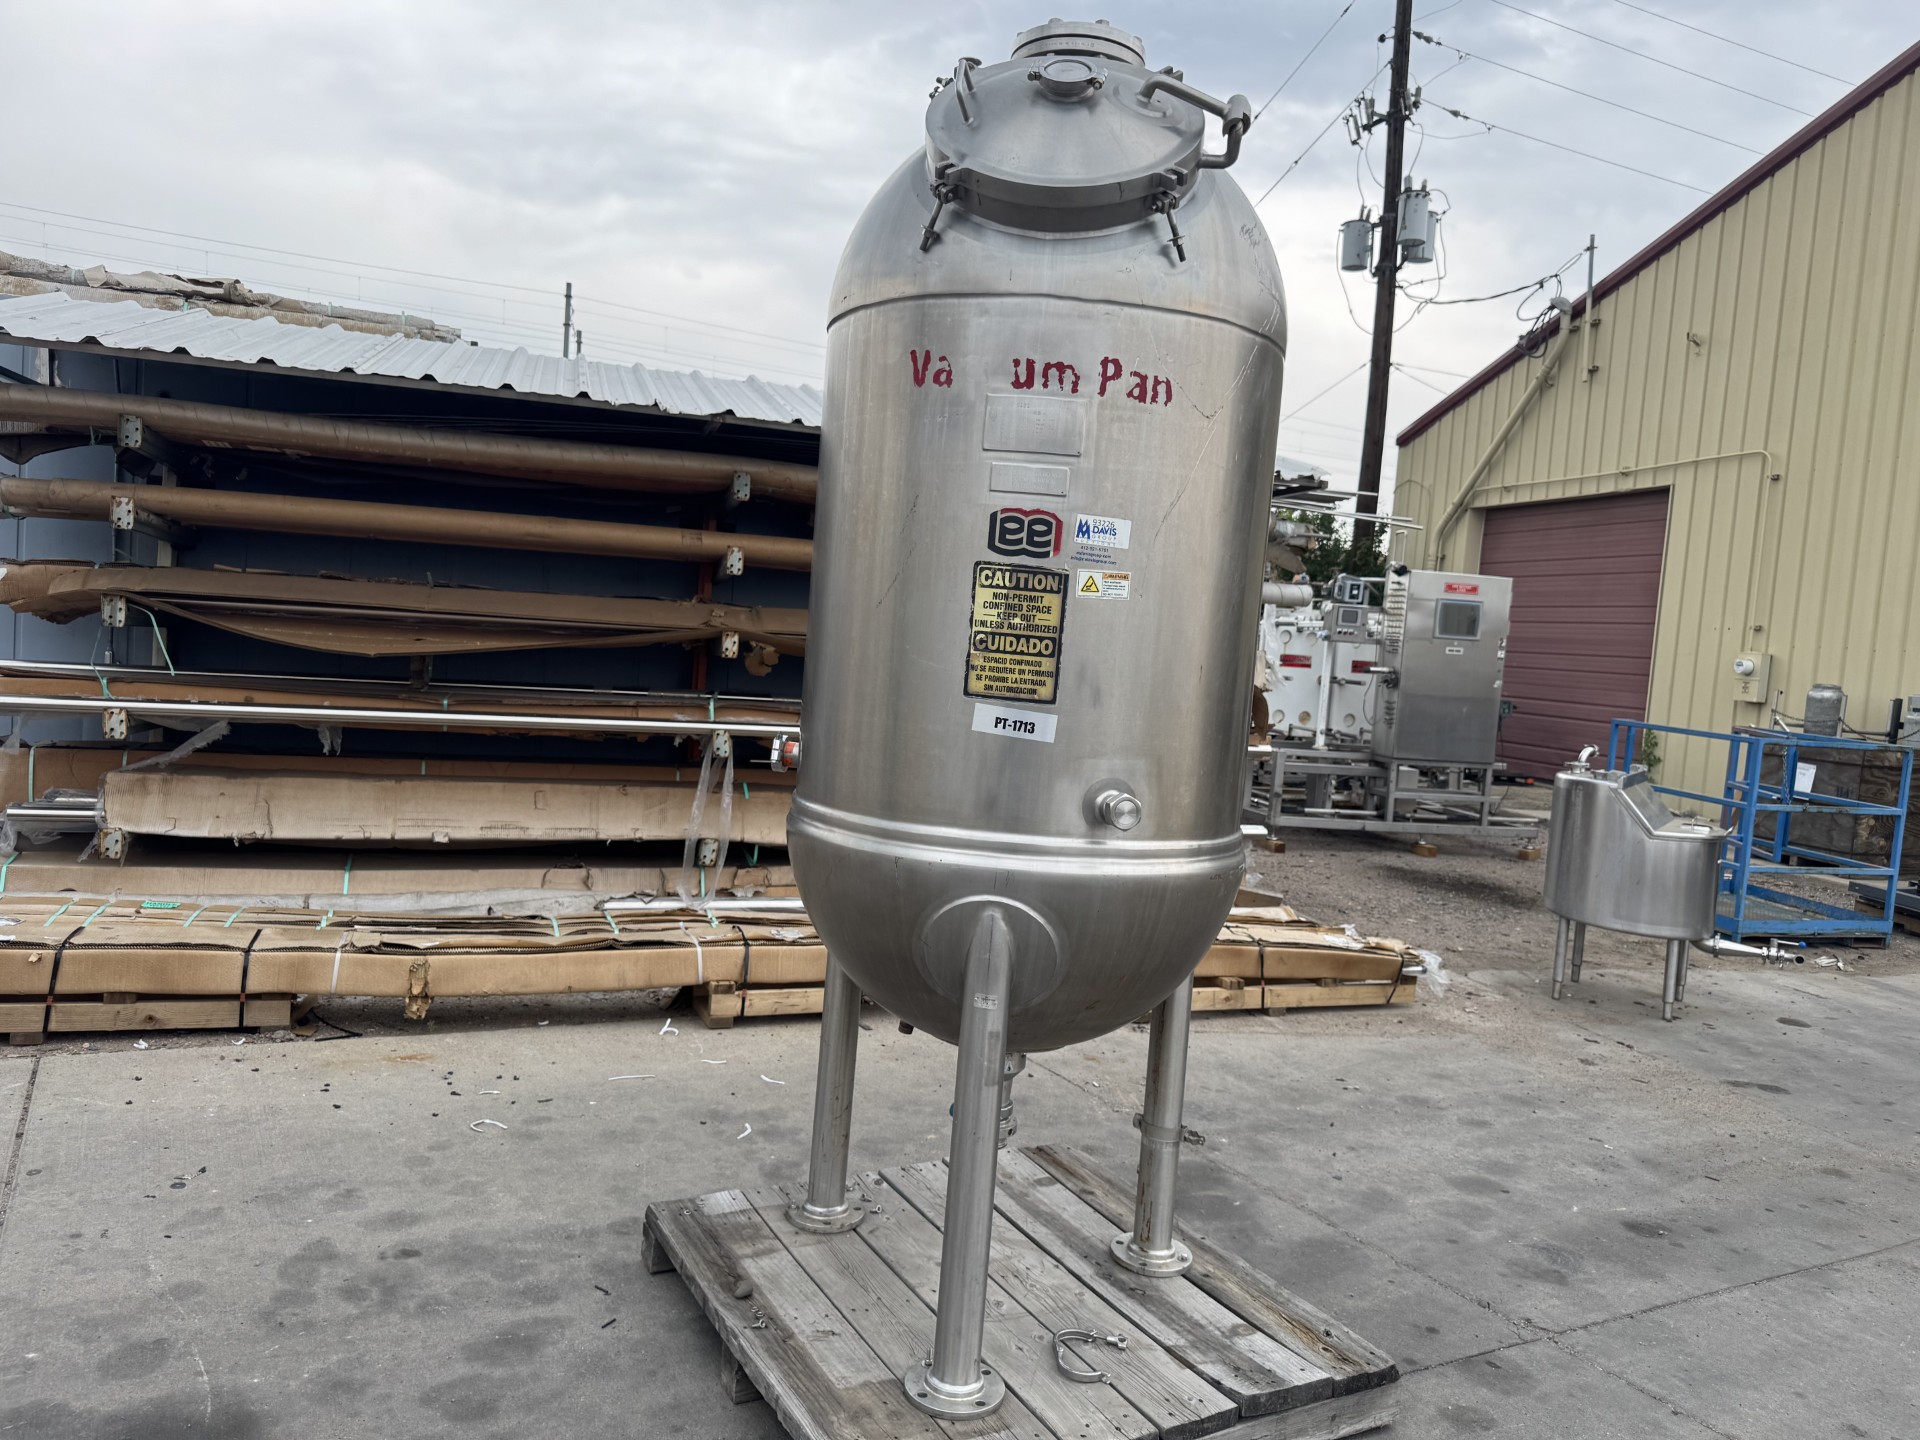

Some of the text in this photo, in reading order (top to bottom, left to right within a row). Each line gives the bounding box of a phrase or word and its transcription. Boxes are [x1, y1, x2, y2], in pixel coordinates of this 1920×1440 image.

[1097, 356, 1173, 408] Pan
[1092, 518, 1115, 528] 93226
[1092, 525, 1117, 536] DAVIS
[980, 569, 1059, 591] CAUTION
[992, 591, 1045, 604] NON-PERMIT
[983, 600, 1052, 614] CONFINED SPACE
[996, 611, 1037, 622] KEEP OUT
[974, 619, 1058, 634] UNLESS AUTHORIZED
[975, 633, 1053, 655] CUIDADO
[983, 656, 1042, 667] ESPACIO CONFINADO
[970, 664, 1054, 678] NO SE REQUIERE UN PERMISO
[975, 673, 1047, 687] SE PROHIBE LA ENTRADA
[995, 685, 1038, 695] AUTORIZACION
[994, 716, 1036, 734] PT-1713
